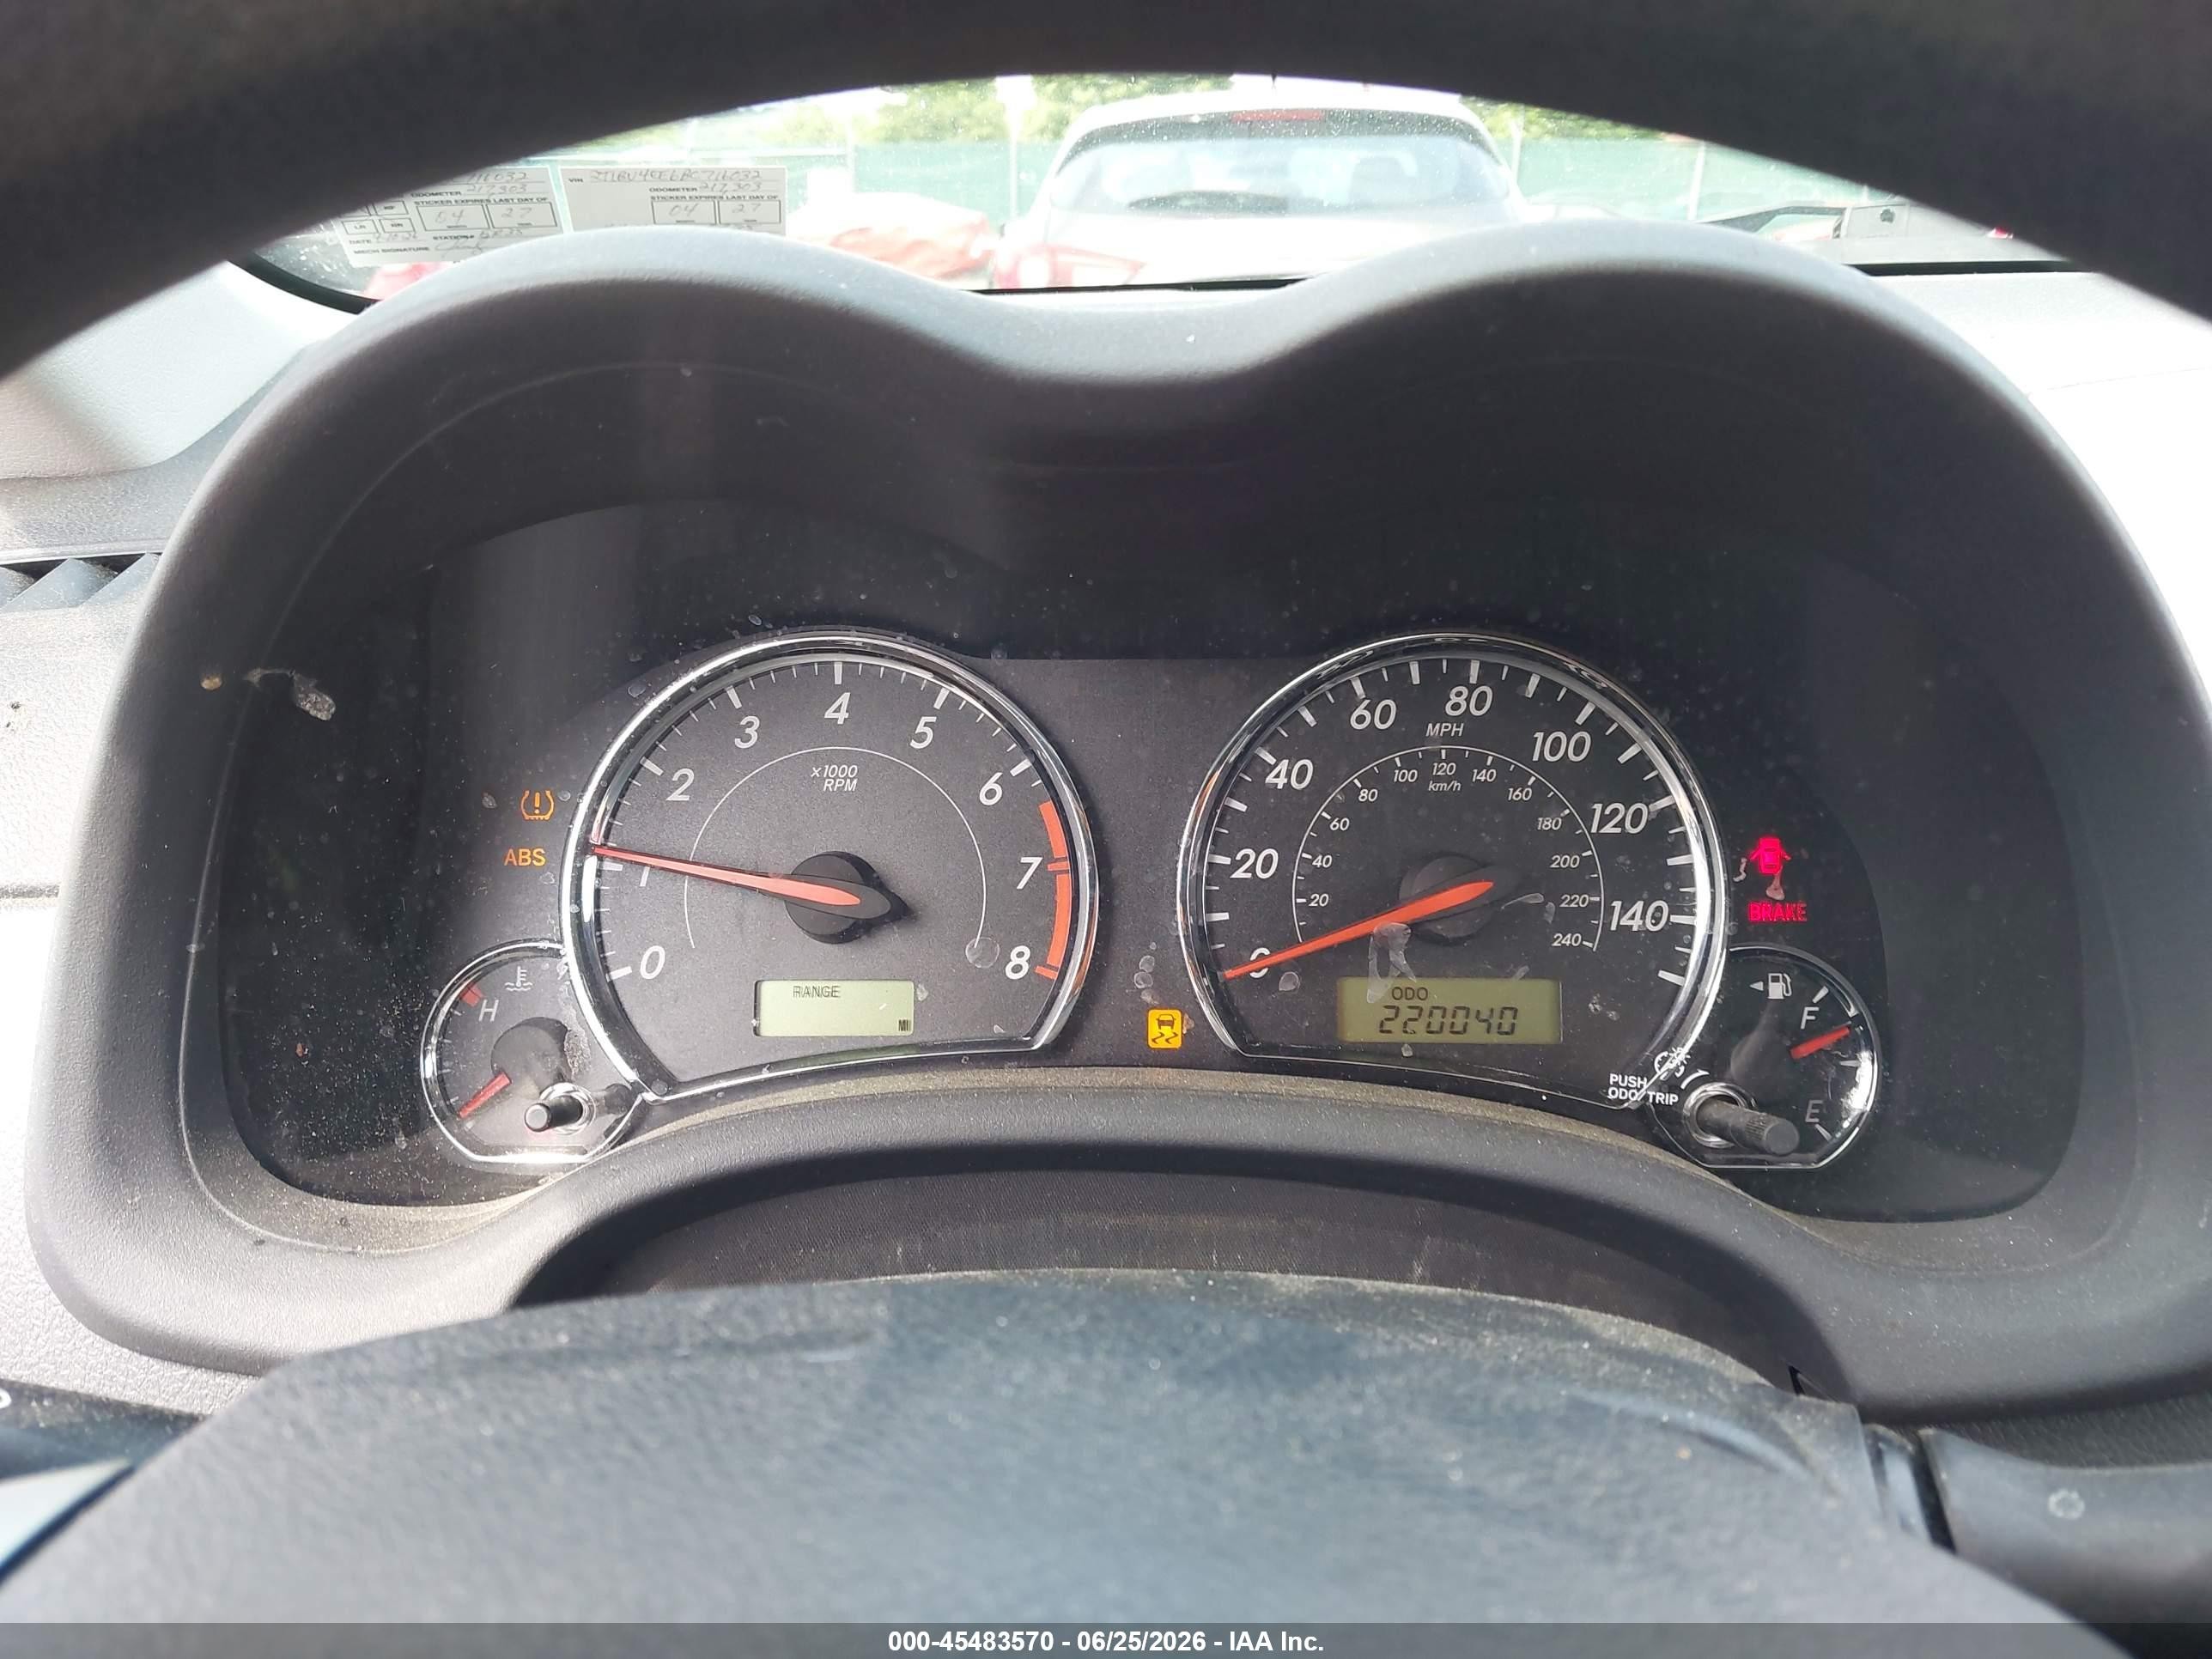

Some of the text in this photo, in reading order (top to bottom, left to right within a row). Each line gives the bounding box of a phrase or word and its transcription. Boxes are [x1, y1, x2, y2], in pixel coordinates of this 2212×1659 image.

[823, 692, 851, 725] 4
[1445, 685, 1493, 716] 80
[1351, 696, 1396, 730] 60
[734, 715, 760, 749] 3
[909, 716, 937, 750] 5
[1425, 722, 1464, 737] MPH
[1532, 731, 1591, 763] 100
[1265, 757, 1314, 790] 40
[1394, 769, 1418, 782] 100
[1432, 762, 1456, 775] 120
[1472, 769, 1497, 782] 140
[665, 768, 695, 801] 2
[823, 778, 858, 792] RPM
[979, 772, 1003, 805] 6
[1358, 788, 1378, 802] 80
[1428, 780, 1462, 792] km/h
[1508, 787, 1533, 801] 160
[1328, 817, 1350, 831] 60
[1537, 817, 1562, 830] 180
[1590, 802, 1649, 834] 120
[505, 848, 546, 866] ABS
[1231, 848, 1279, 879] 20
[1311, 854, 1333, 868] 40
[1550, 854, 1580, 868] 200
[1016, 856, 1043, 890] 7
[1308, 893, 1329, 907] 20
[1559, 894, 1589, 908] 220
[1610, 900, 1669, 932] 140
[1748, 901, 1808, 922] BRAKE
[1552, 933, 1582, 946] 240
[639, 945, 665, 980] 0
[1005, 945, 1031, 980] 8
[793, 985, 841, 998] RANGE
[1391, 986, 1429, 1001] ODO
[478, 999, 500, 1022] H
[1378, 1005, 1519, 1036] 220040
[1800, 1006, 1820, 1030] F
[1608, 1073, 1648, 1089] PUSH
[1805, 1101, 1823, 1124] E
